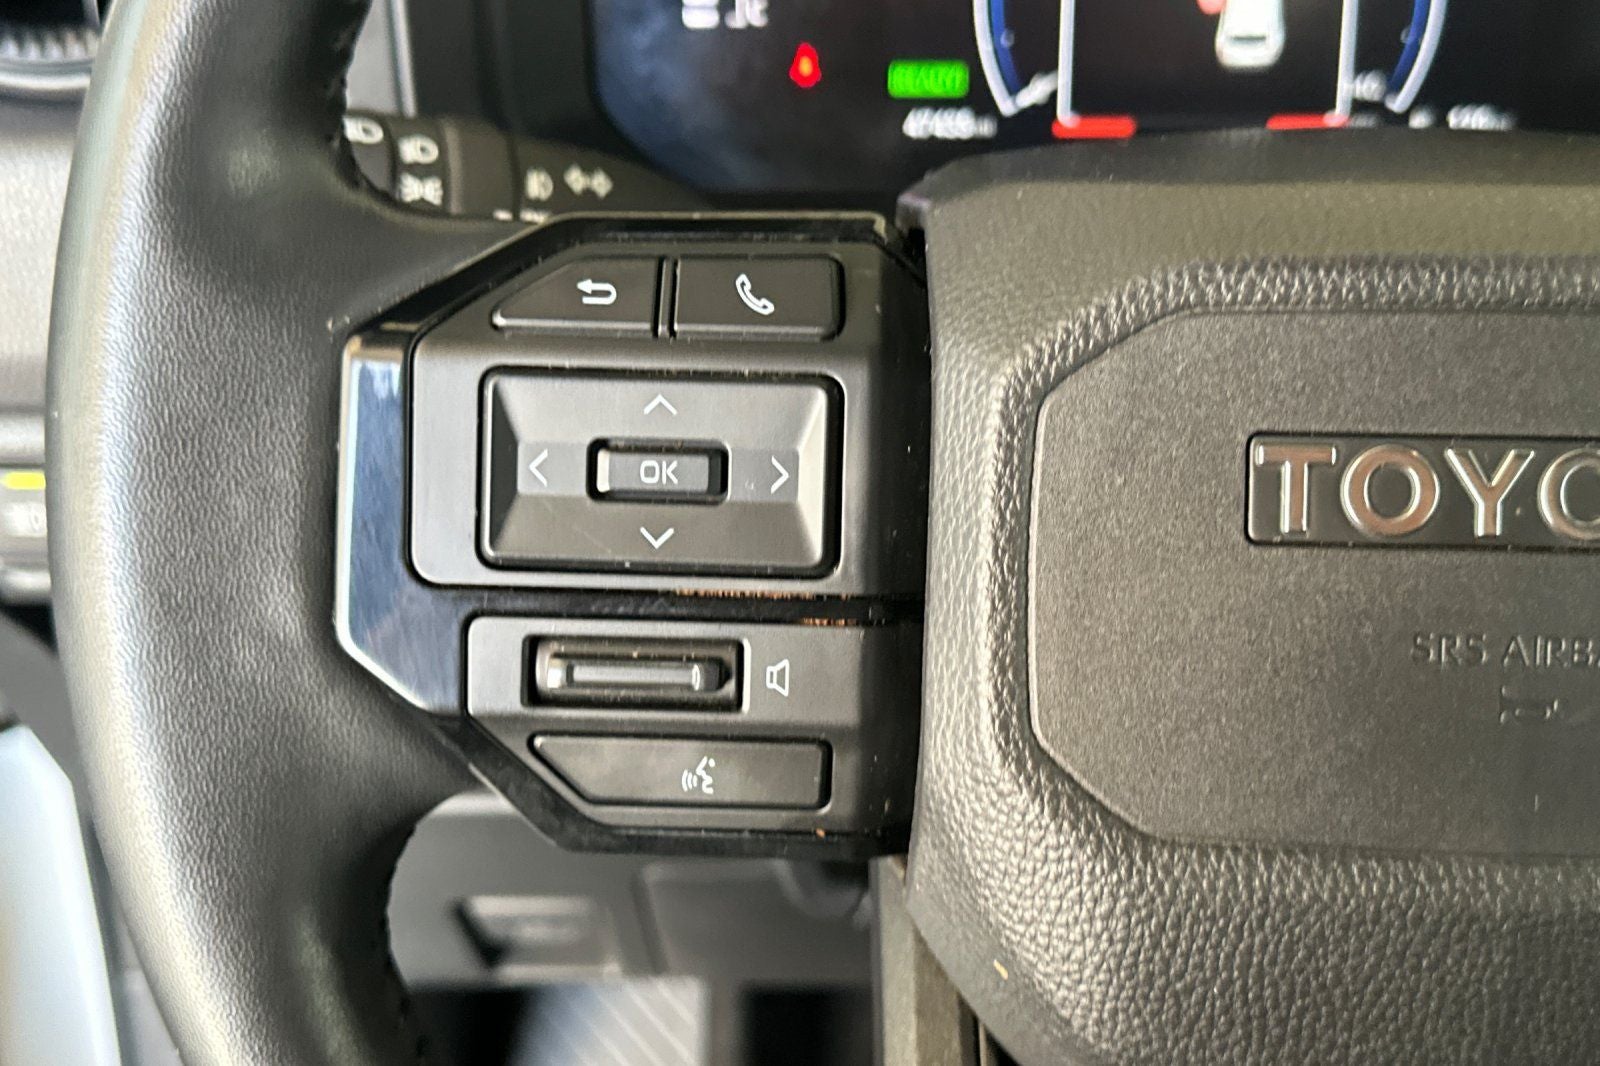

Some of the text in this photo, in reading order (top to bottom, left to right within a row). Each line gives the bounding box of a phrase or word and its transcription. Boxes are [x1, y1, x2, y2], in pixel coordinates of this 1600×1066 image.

[639, 459, 679, 485] OK
[1254, 443, 1600, 541] TOYO
[1410, 632, 1600, 669] SRS AIRB
